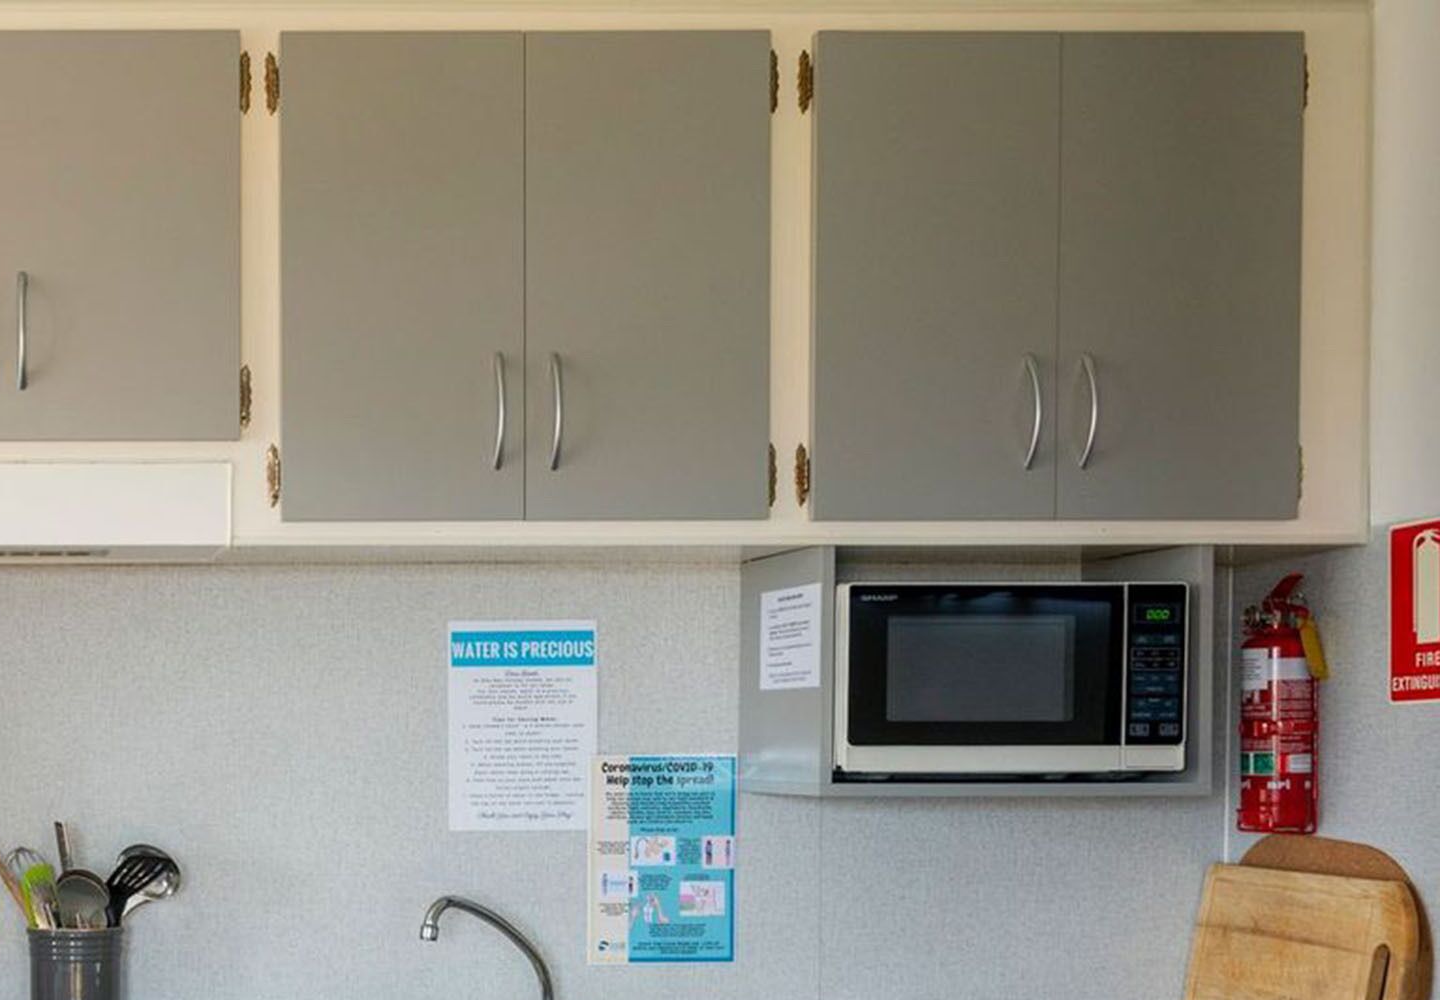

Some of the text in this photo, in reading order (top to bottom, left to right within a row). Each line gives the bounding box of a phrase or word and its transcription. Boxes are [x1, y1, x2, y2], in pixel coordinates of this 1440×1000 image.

[452, 640, 594, 659] WATER IS PRECIOUS
[606, 775, 630, 788] Help
[631, 775, 654, 788] stop
[656, 775, 674, 785] the
